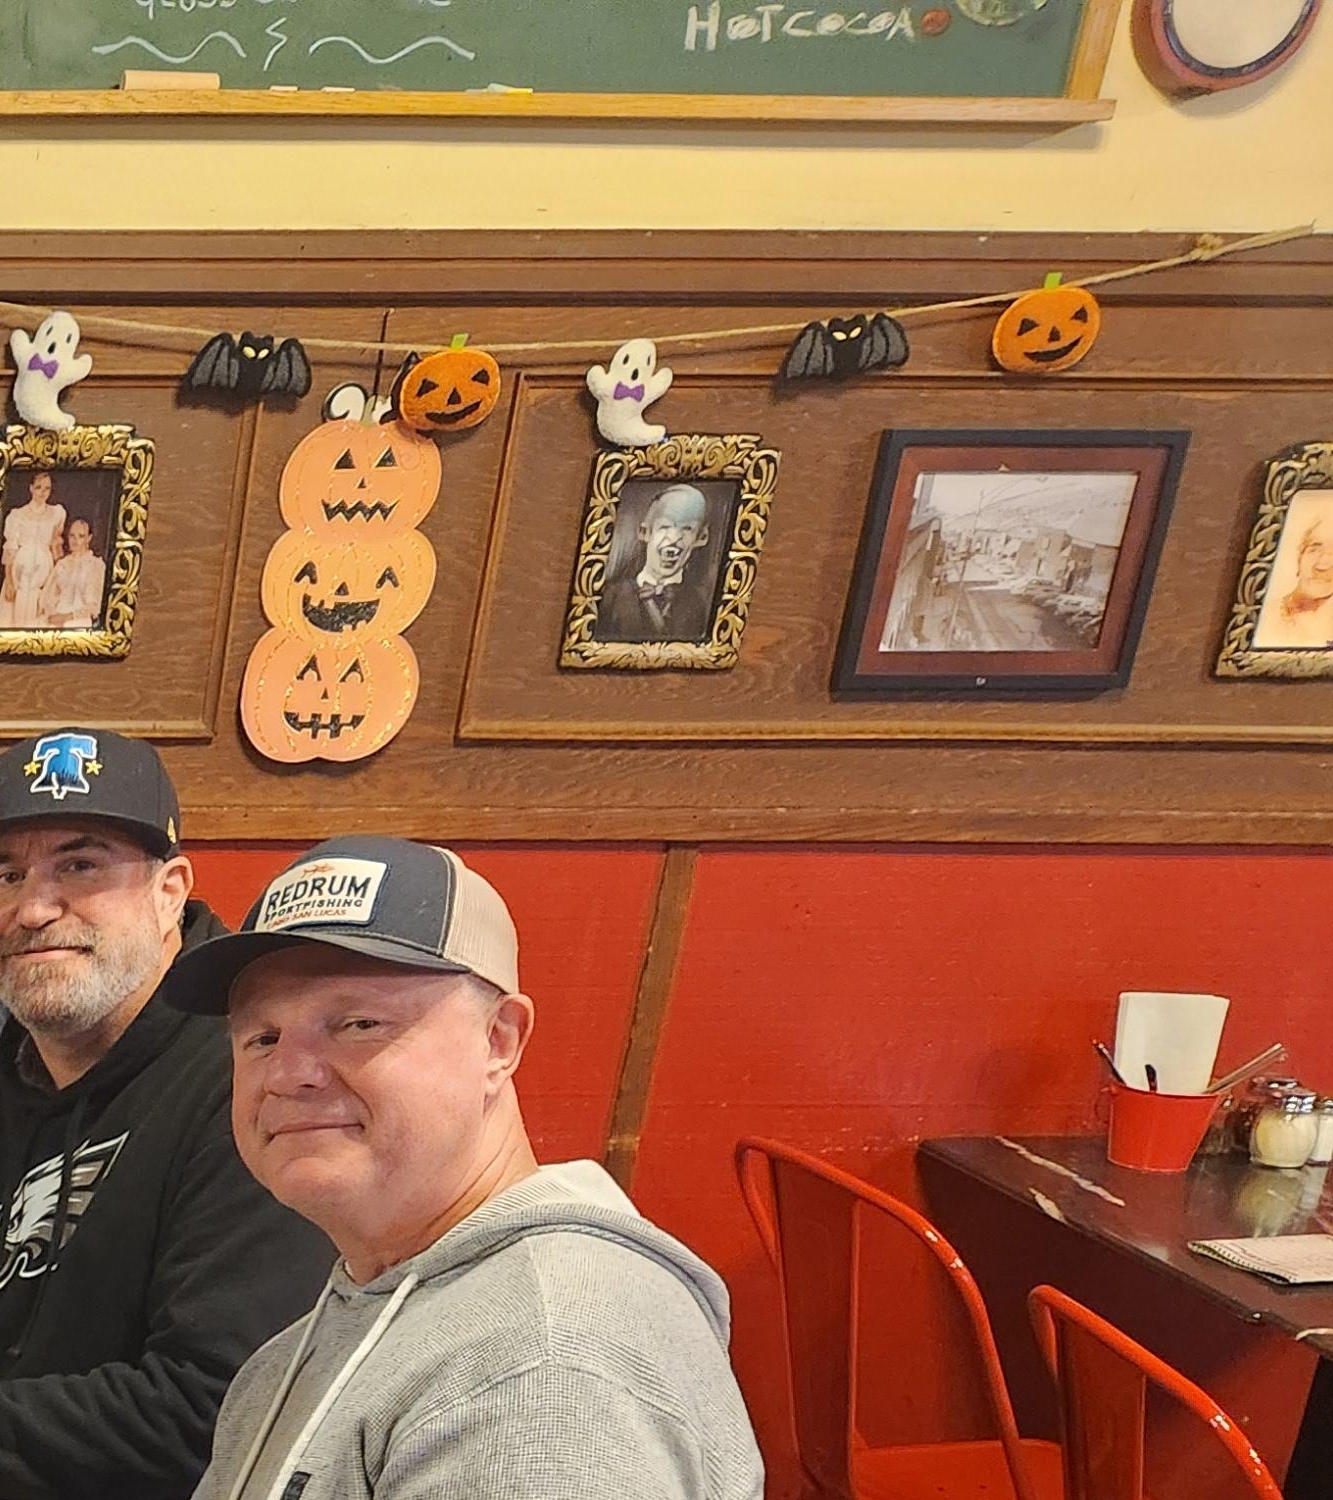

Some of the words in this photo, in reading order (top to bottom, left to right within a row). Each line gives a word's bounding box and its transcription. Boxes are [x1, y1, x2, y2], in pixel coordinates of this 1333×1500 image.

[268, 874, 372, 911] REDRUM
[264, 898, 364, 924] SPORTFISHING
[293, 910, 312, 921] SAN
[314, 908, 348, 918] LUCAS
